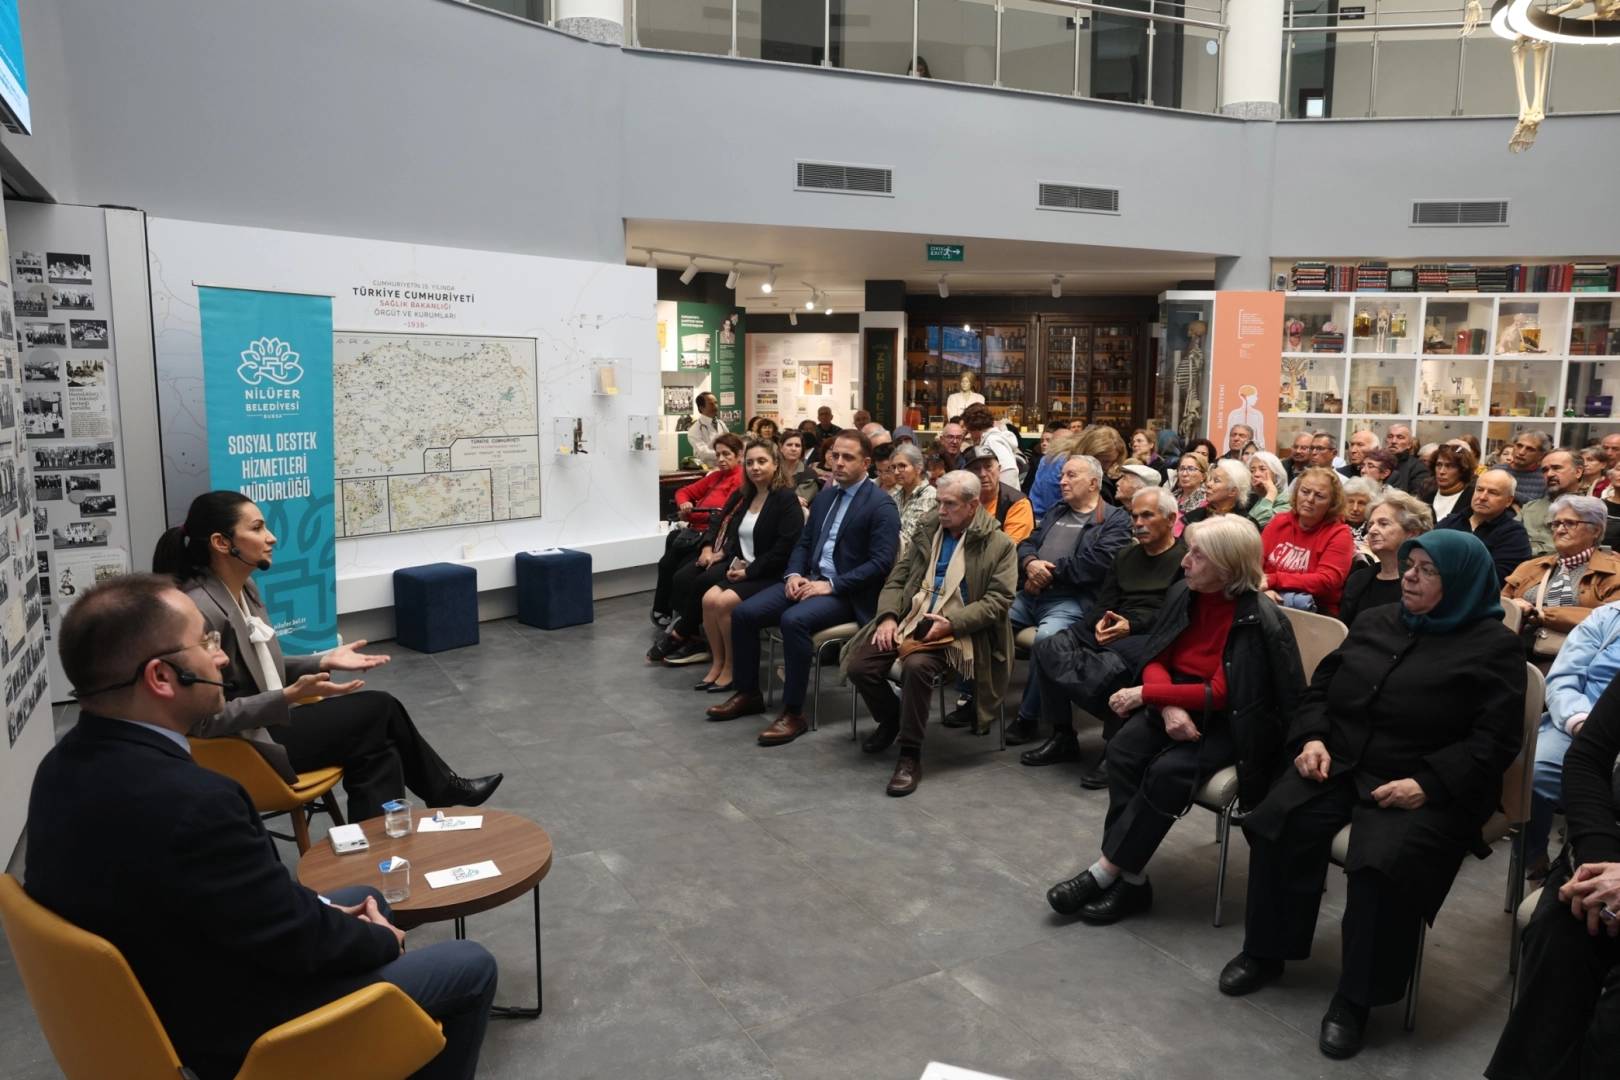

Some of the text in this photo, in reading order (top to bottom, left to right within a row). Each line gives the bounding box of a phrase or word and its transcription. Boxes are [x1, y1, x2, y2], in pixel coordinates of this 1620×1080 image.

[352, 286, 474, 303] TÜRKİYE CUMHURİYETİ
[374, 308, 400, 316] ÖRGÜT
[414, 311, 456, 319] KURUMLARI
[380, 300, 451, 310] SAĞLIK BAKANLIĞI
[244, 387, 300, 400] NİLÜFER
[876, 352, 885, 426] ZEHİRLE
[246, 401, 300, 412] BELEDİYESİ
[228, 432, 317, 455] SOSYAL DESTEK
[242, 453, 307, 480] HİZMETLERİ
[240, 476, 310, 503] MÜDÜRLÜĞÜ
